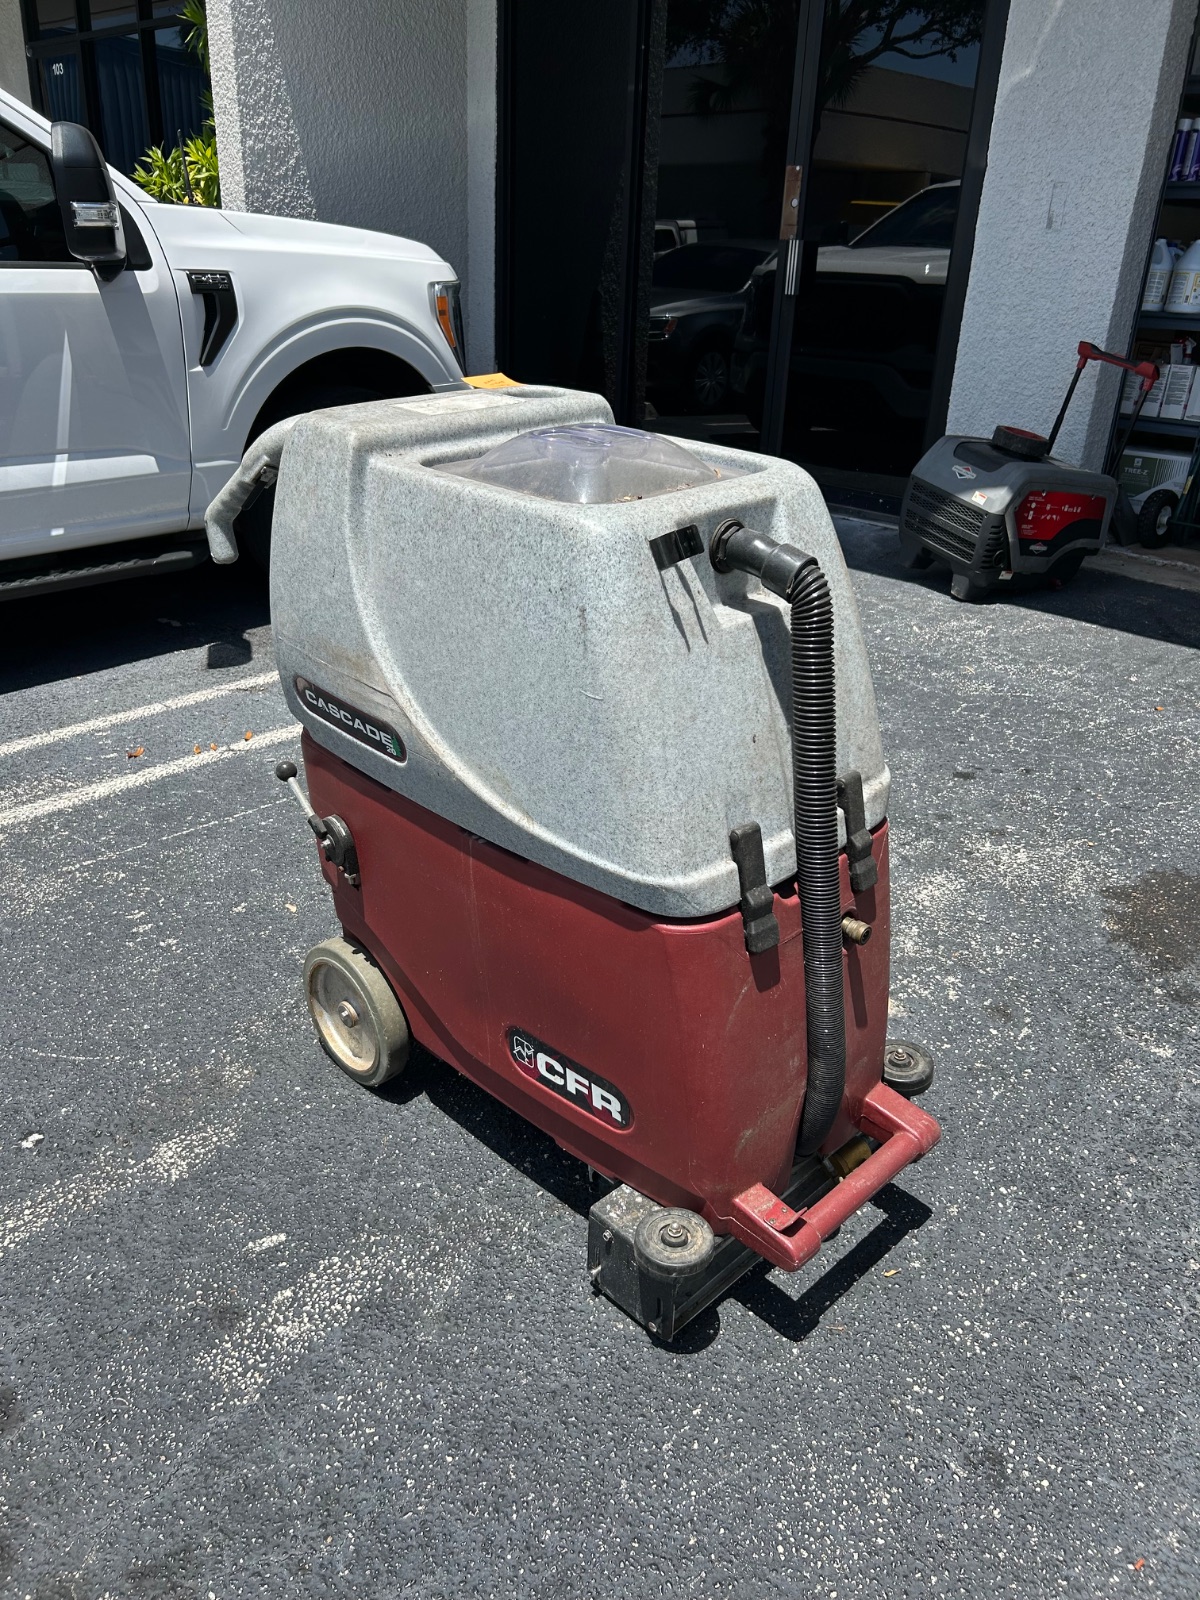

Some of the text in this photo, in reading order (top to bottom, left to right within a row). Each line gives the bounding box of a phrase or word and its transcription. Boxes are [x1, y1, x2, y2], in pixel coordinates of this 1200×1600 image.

[52, 62, 64, 76] 103
[305, 689, 393, 748] CASCADE
[386, 745, 397, 756] 20
[536, 1052, 622, 1122] CFR
